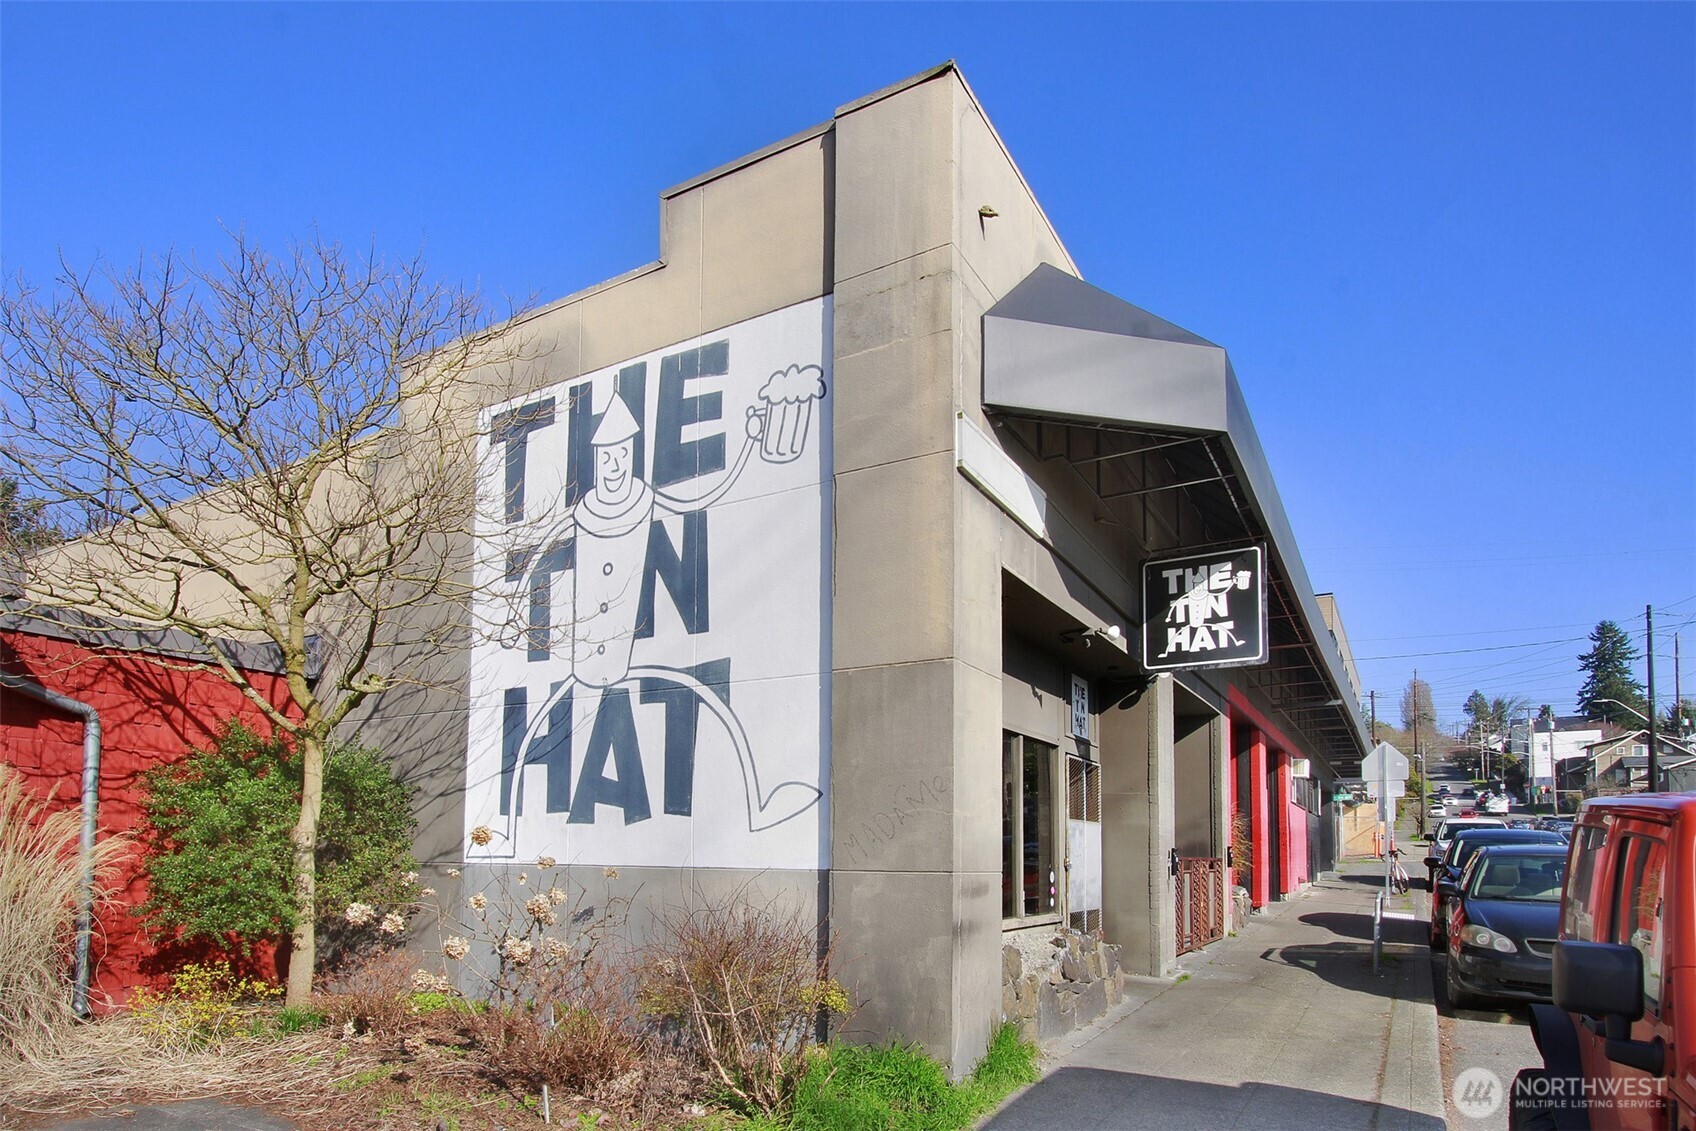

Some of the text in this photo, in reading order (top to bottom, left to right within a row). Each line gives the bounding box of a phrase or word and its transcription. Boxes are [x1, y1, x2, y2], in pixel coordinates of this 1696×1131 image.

[490, 338, 729, 524] THE
[1162, 561, 1232, 595] THE
[1167, 620, 1234, 652] HAT
[500, 657, 731, 825] HAT
